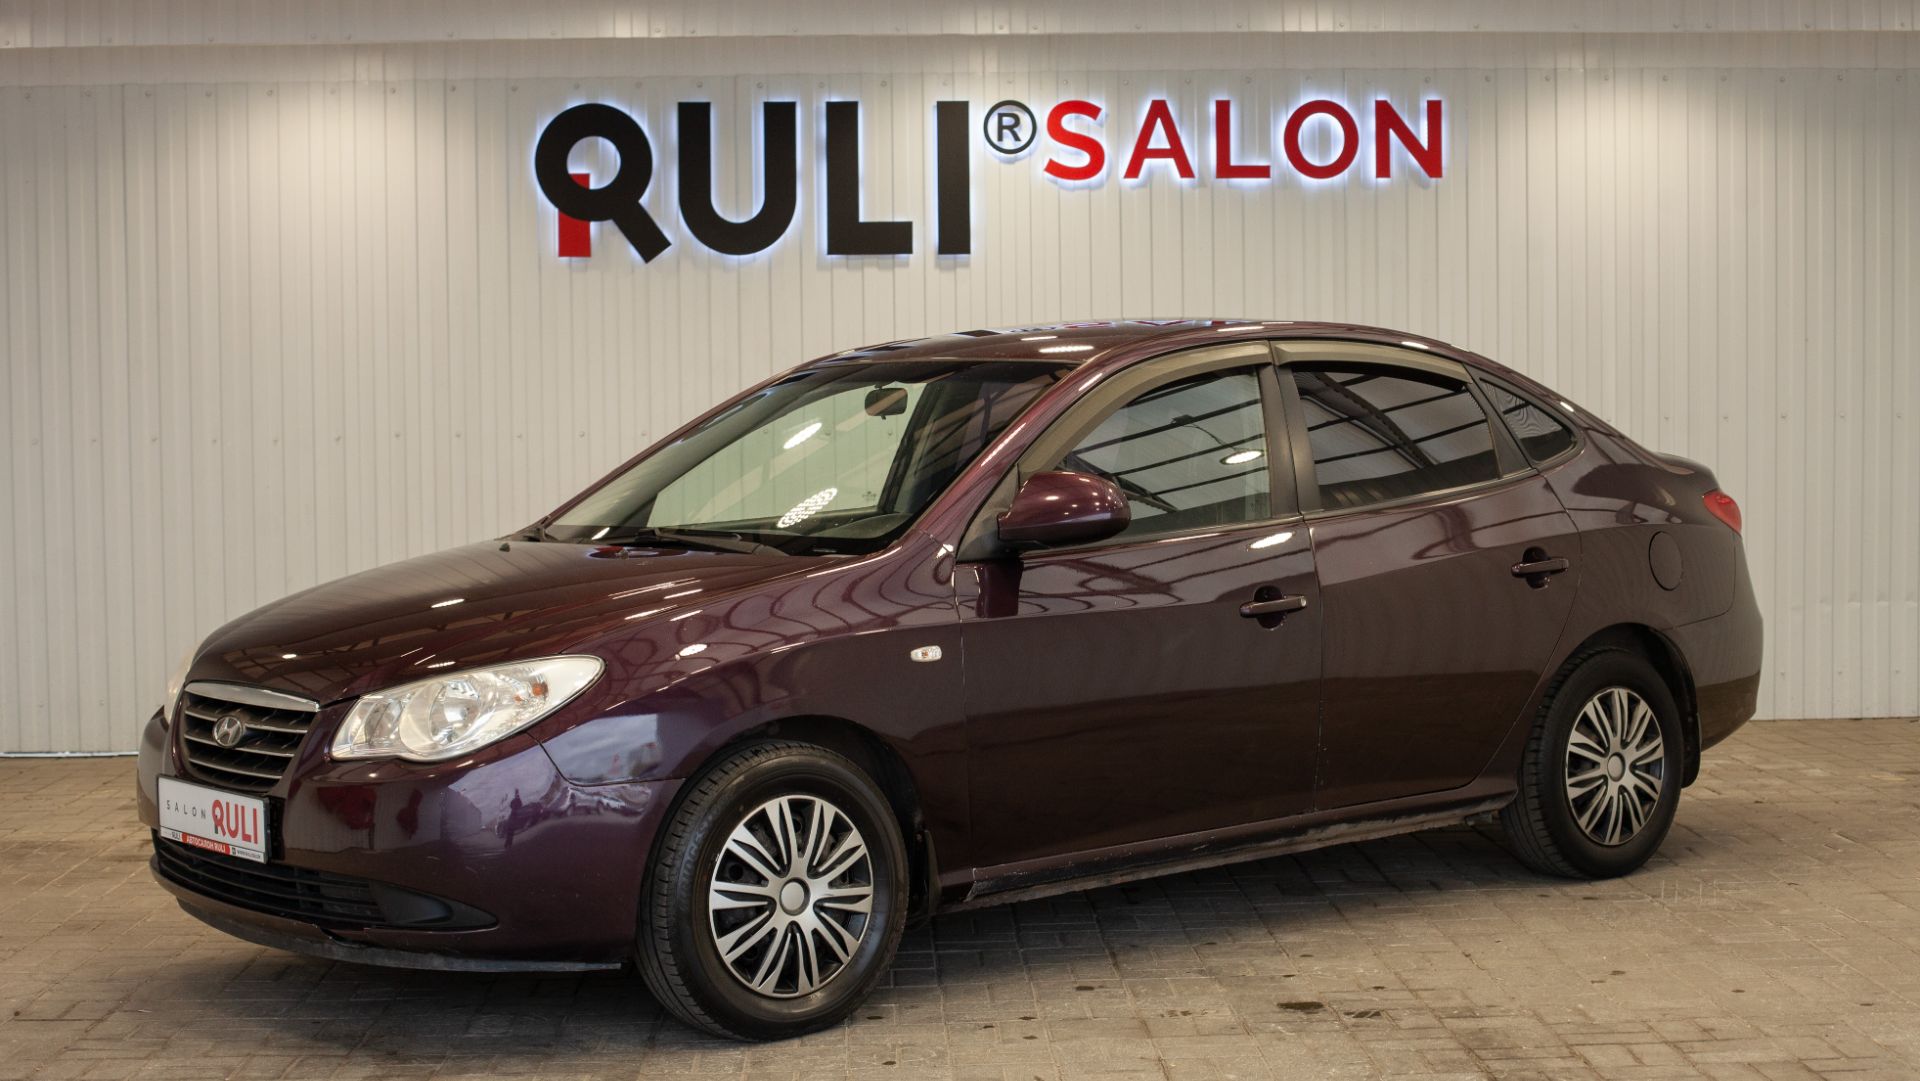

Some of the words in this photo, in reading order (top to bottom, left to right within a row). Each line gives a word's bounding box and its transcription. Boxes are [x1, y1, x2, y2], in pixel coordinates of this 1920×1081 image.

[1043, 99, 1443, 180] SALON
[166, 800, 206, 819] SALON
[212, 799, 258, 845] RULI
